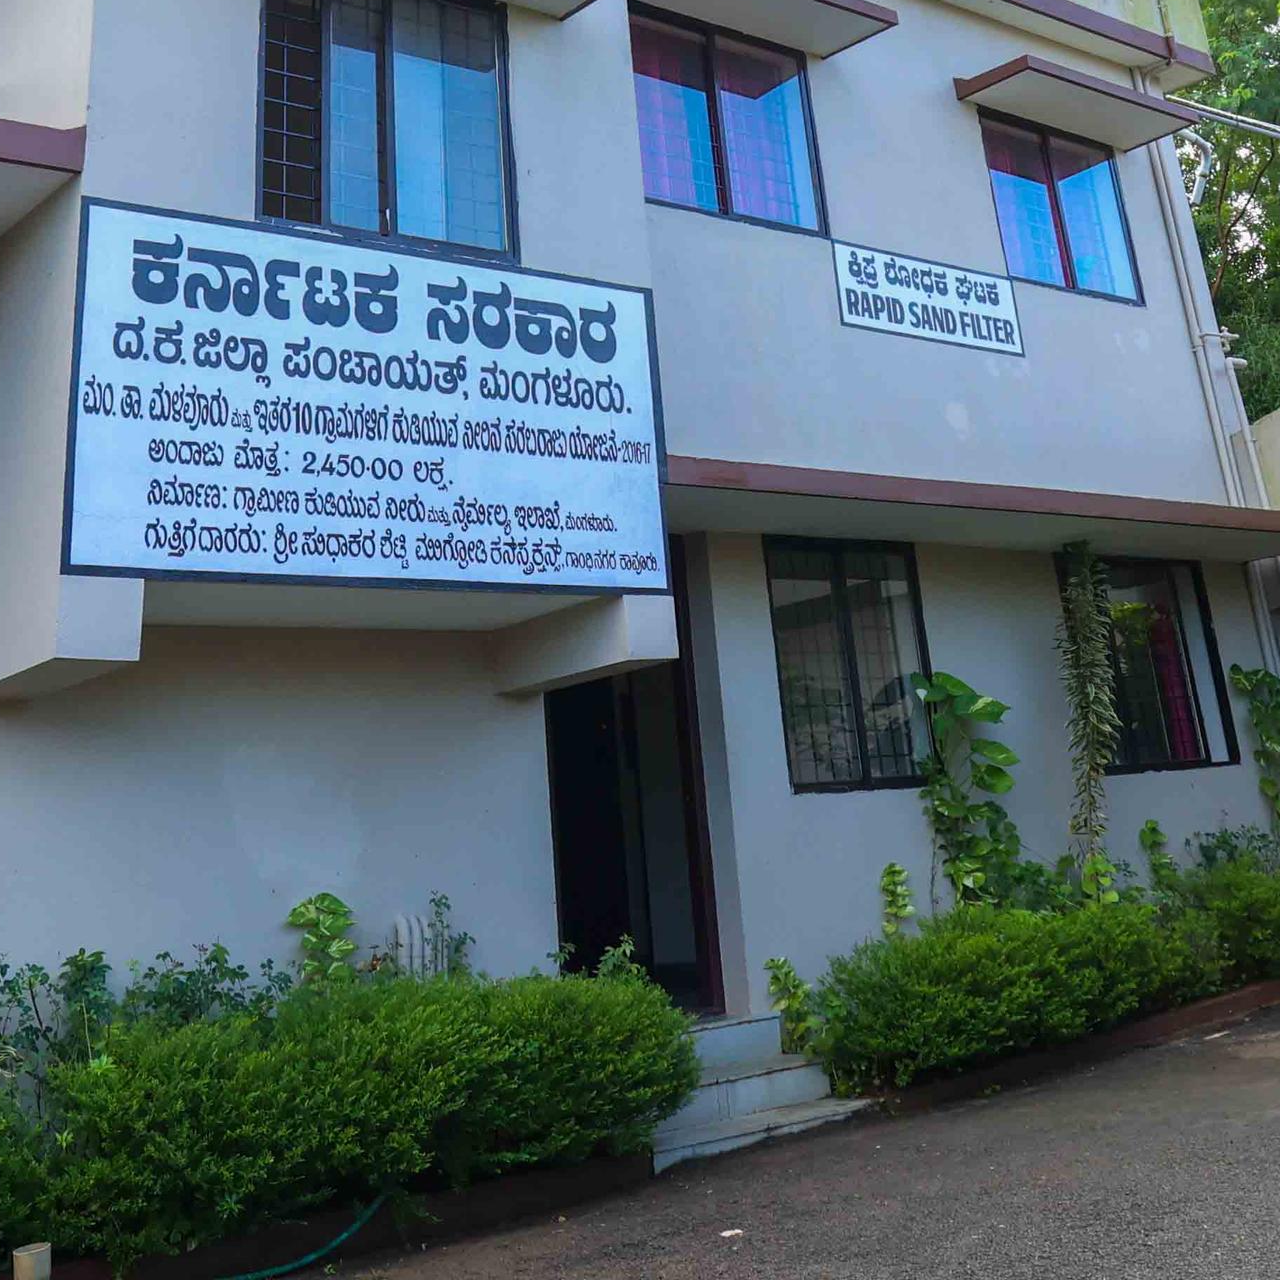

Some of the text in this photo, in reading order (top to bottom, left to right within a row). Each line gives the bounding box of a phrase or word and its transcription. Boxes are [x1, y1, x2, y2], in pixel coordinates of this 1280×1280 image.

[132, 233, 617, 364] ಕರ್ನಾಟಕ ಸರಕಾರ
[848, 250, 1000, 306] ಕ್ಷಿಪ್ರ ಶೋಧಕ ಘಟಕ
[845, 287, 1016, 345] RAPID SAND FILTER
[283, 336, 469, 400] ಪಂಚಾಯತ್,
[479, 360, 632, 414] ಮಂಗಳೂರು.
[149, 381, 229, 431] ಮಳವೂರು
[230, 408, 254, 433] ಮತ್ತು
[392, 407, 458, 449] ಕುಡಿಯುವ
[462, 417, 502, 457] ನೀರಿನ
[504, 419, 567, 460] ಸರಬರಾಜು
[148, 438, 224, 466] ಅಂದಾಜು
[233, 485, 299, 517] ಗ್ರಾಮೀಣ
[304, 487, 380, 520] ಕುಡಿಯುವ
[385, 493, 426, 522] ನೀರು
[428, 507, 451, 526] ಮತ್ತು
[273, 523, 298, 563] ಶ್ರೀ
[301, 526, 376, 563] ಸುಧಾಕರ
[380, 527, 409, 569] ಶೆಟ್ಟಿ
